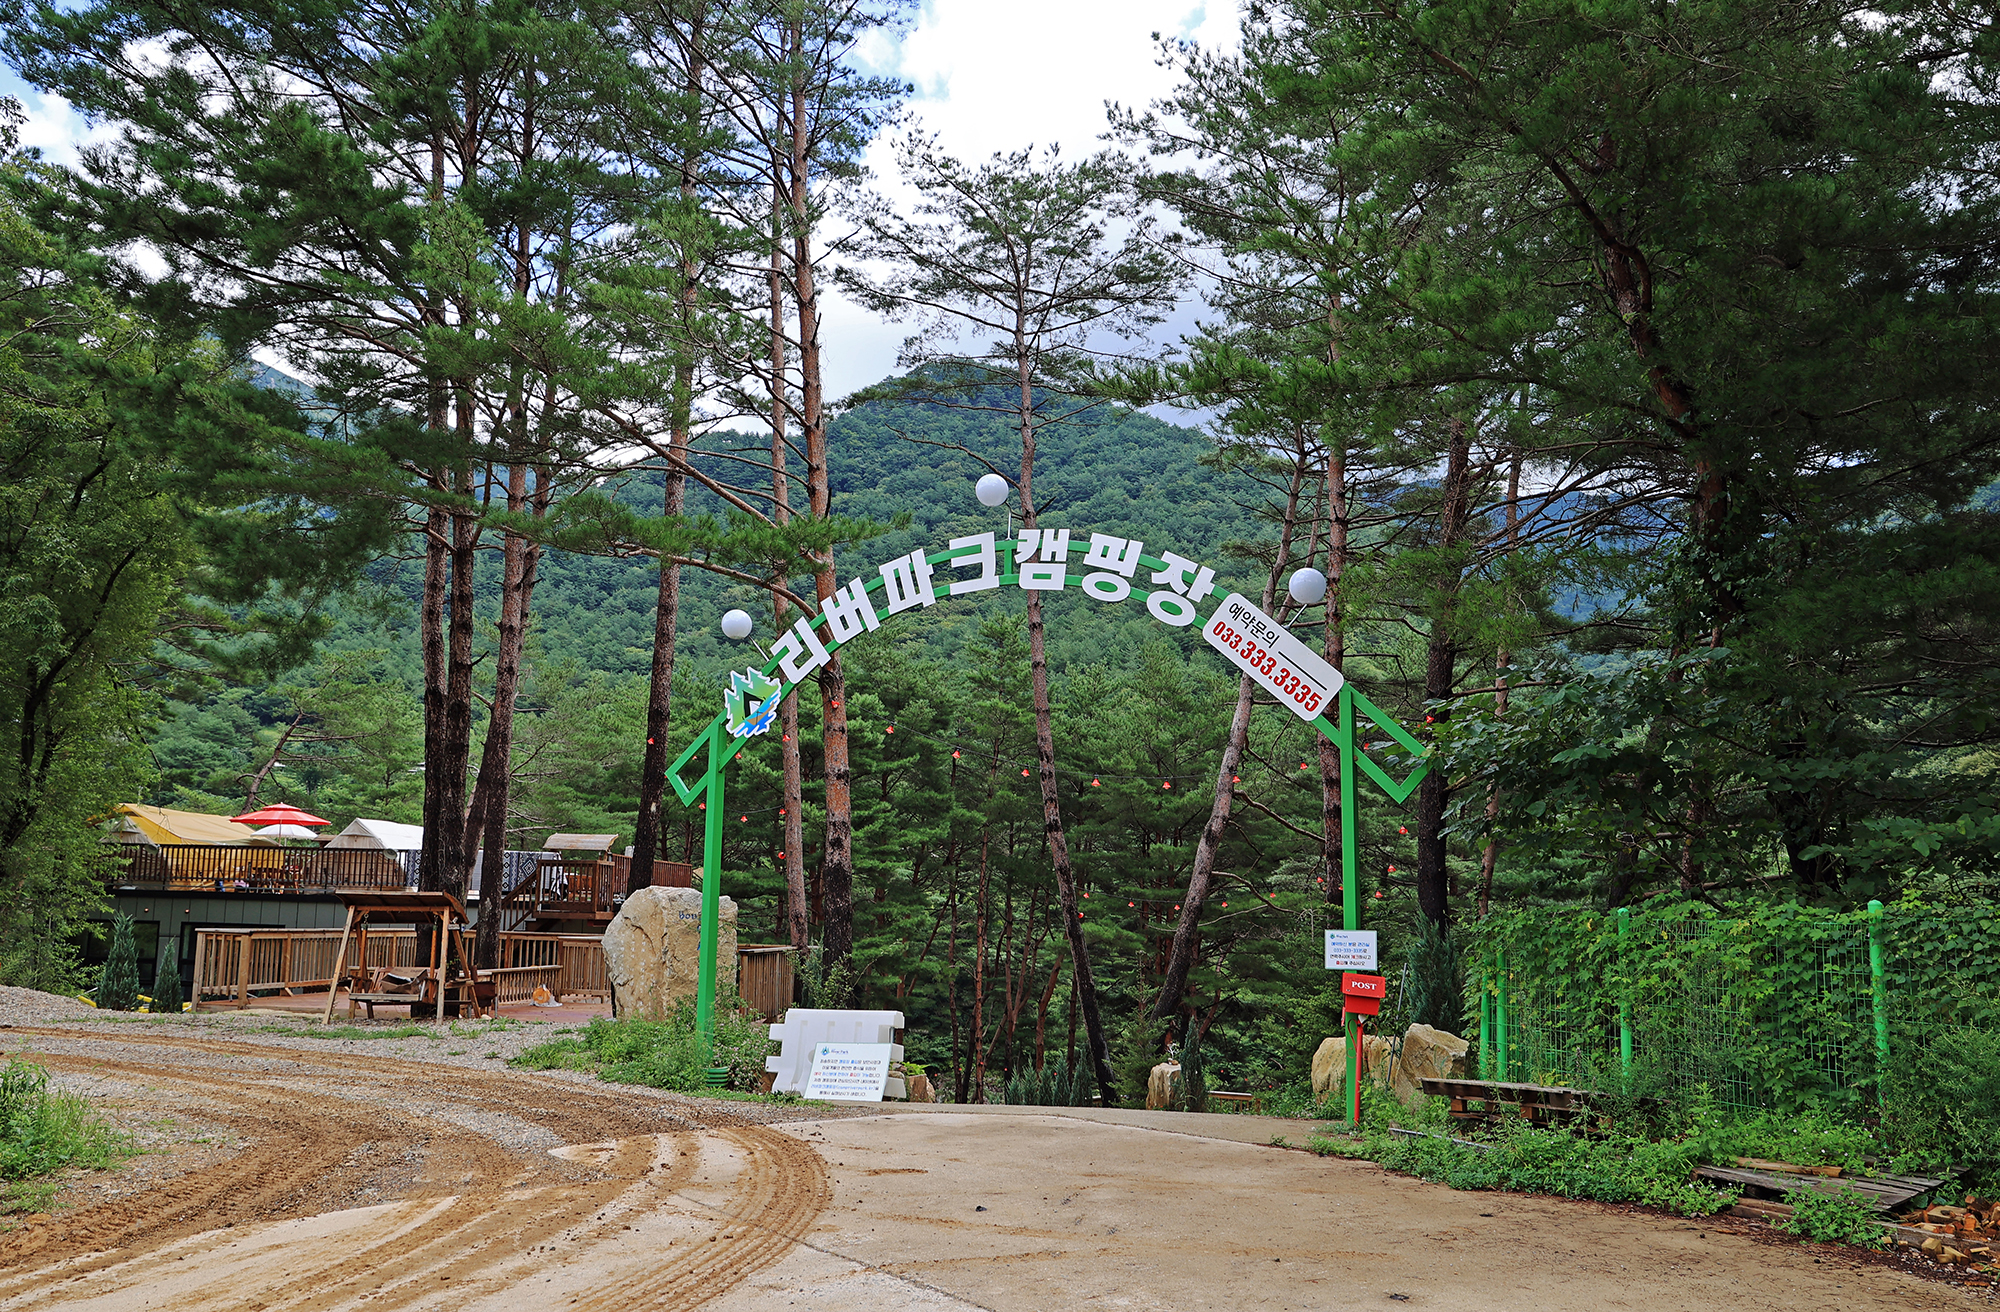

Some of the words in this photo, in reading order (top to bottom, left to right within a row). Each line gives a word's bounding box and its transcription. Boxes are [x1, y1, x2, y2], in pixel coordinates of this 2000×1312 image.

[770, 528, 1216, 683] 리버파크캠핑장
[1228, 602, 1280, 649] 예약문의
[1212, 621, 1323, 712] 033.333.3335
[1351, 981, 1377, 990] POST
